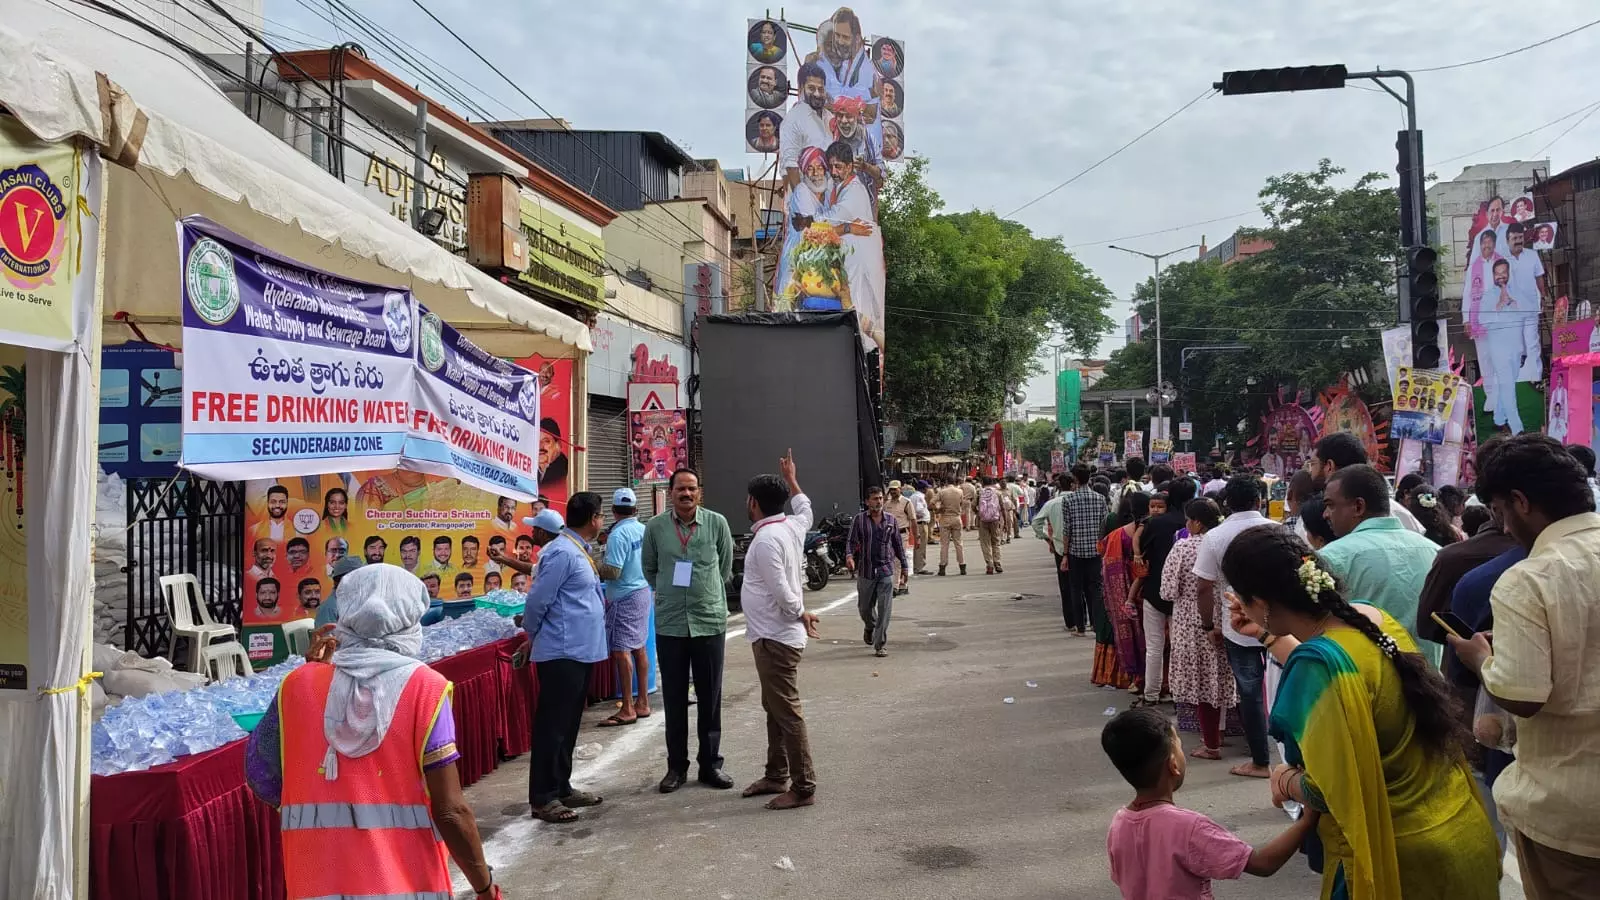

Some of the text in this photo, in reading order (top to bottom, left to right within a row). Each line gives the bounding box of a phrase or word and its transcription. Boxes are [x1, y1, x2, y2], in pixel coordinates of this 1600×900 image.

[35, 177, 62, 214] CLUBS
[0, 252, 49, 274] INTERNATIONAL
[0, 287, 52, 306] ive to Serve
[264, 282, 318, 313] Hyderabad
[244, 304, 272, 330] Water
[274, 310, 305, 341] Supply
[307, 320, 324, 338] and
[325, 321, 363, 348] Sewrage
[364, 327, 387, 349] Board
[248, 348, 384, 395] ఉచిత త్రాగు నీరు
[634, 343, 678, 376] Bata
[445, 362, 464, 384] Water
[192, 391, 259, 422] FREE
[267, 395, 358, 424] DRINKING
[252, 436, 383, 456] SECUNDERABAD ZONE
[451, 426, 504, 463] DRINKING
[506, 447, 532, 473] WATER
[500, 472, 518, 486] ZONE
[366, 510, 491, 519] Cheera Suchitra Srikanth
[390, 521, 429, 529] Corporator,
[431, 521, 474, 530] Ramgopalpet
